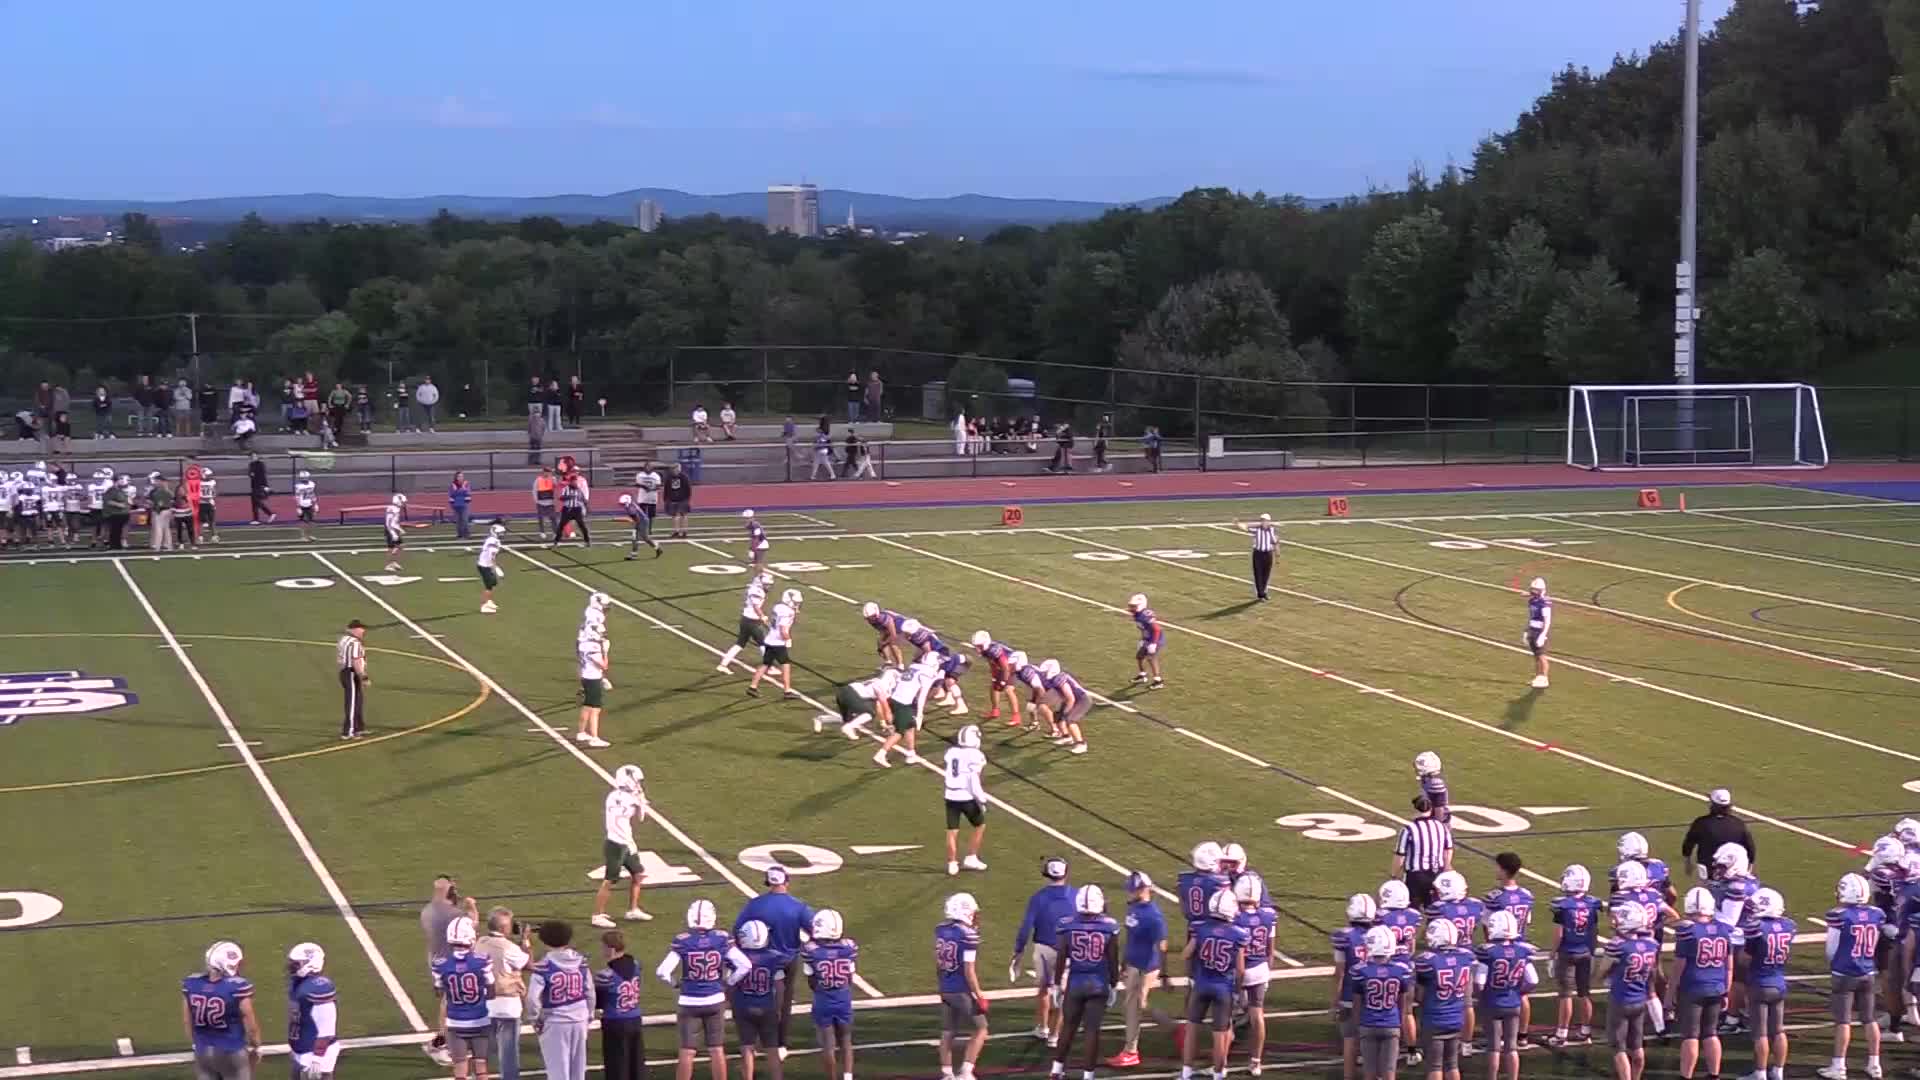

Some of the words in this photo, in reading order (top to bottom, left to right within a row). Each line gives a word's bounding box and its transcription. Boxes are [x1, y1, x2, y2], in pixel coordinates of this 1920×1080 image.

[1333, 499, 1347, 512] 10
[1644, 492, 1657, 504] G
[1005, 508, 1023, 522] 20
[1274, 805, 1532, 841] 30
[1188, 886, 1204, 916] 8
[1200, 937, 1233, 973] 45
[1763, 932, 1793, 965] 15
[1850, 923, 1879, 958] 70
[688, 949, 722, 981] 52
[817, 959, 852, 989] 35
[1492, 958, 1527, 989] 24
[447, 973, 479, 1005] 19
[1366, 978, 1400, 1011] 28
[1437, 966, 1470, 1001] 54
[191, 994, 228, 1029] 72
